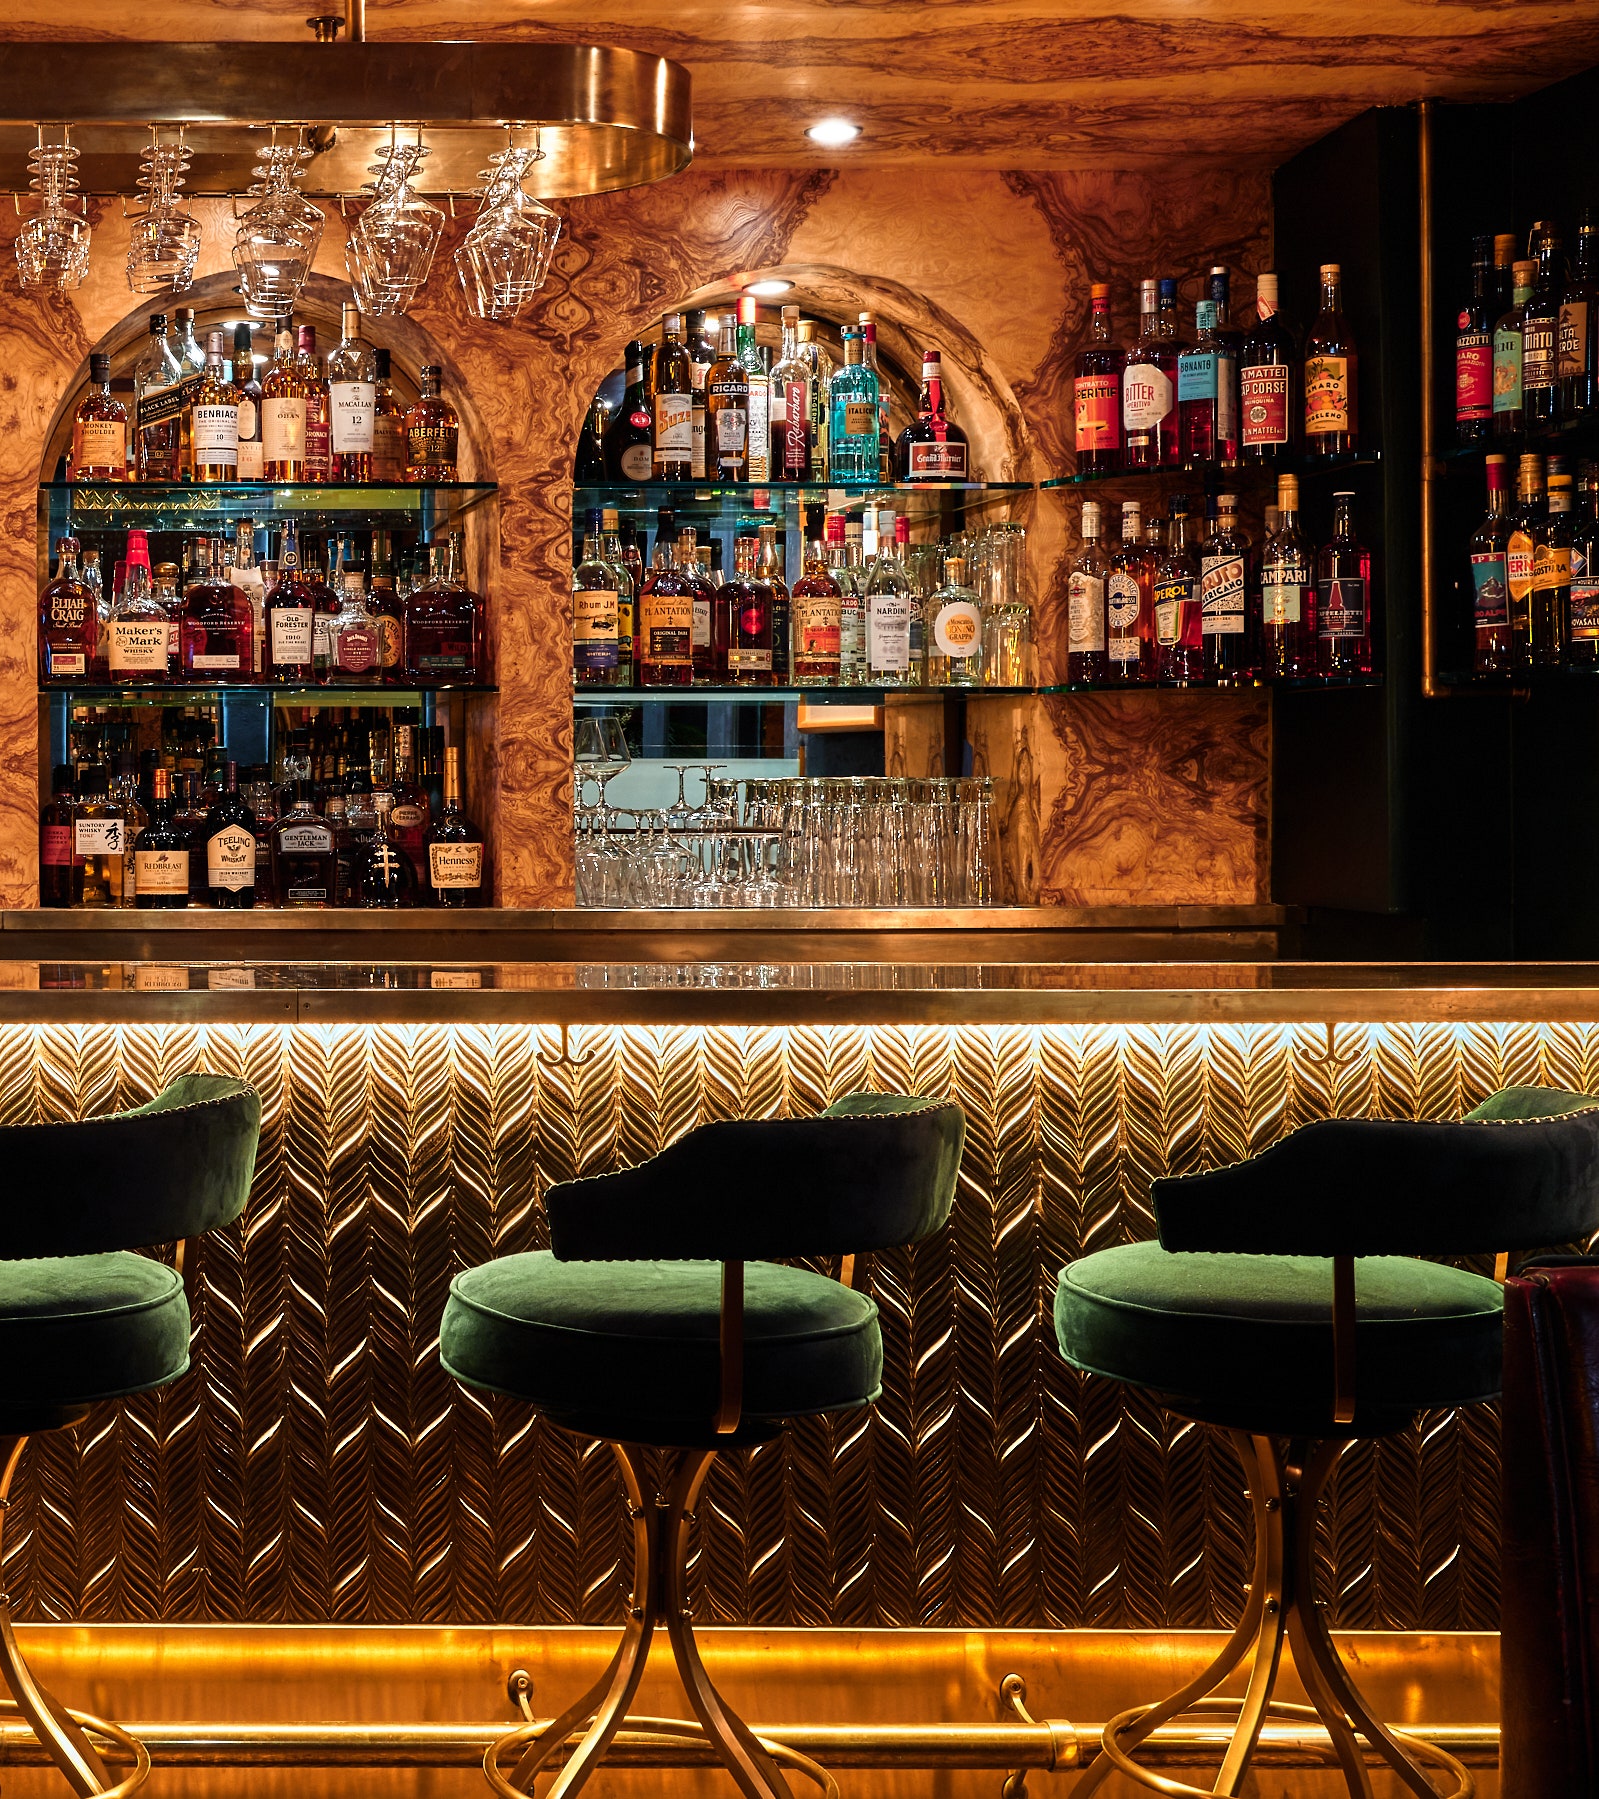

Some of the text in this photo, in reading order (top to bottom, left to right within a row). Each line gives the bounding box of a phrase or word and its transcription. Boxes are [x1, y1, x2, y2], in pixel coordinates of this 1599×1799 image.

[1457, 335, 1489, 346] AZZOTTI
[712, 385, 748, 394] RICARD
[1126, 383, 1155, 403] BITTER
[1253, 382, 1285, 393] CORSE
[1307, 382, 1339, 393] AMARO
[140, 403, 160, 414] BLACK
[160, 396, 180, 407] LABEL
[198, 410, 238, 421] BENRIACH
[351, 415, 362, 424] 12
[787, 387, 805, 447] Rabarbaro
[215, 433, 224, 441] 10
[408, 427, 456, 438] ABERFELD
[1471, 556, 1497, 564] LPE
[51, 596, 85, 613] ELIJAH
[579, 600, 603, 610] Rhum
[50, 608, 85, 622] CRAIG
[644, 607, 691, 616] PLANTATION
[876, 607, 907, 615] NARDINI
[116, 626, 163, 637] Maker's
[129, 637, 163, 646] Mark
[105, 822, 122, 850] 季
[284, 835, 327, 844] GENTLEMAN
[217, 836, 250, 848] TEELING
[221, 855, 247, 864] WHISKEY
[439, 855, 476, 867] Hennessy
